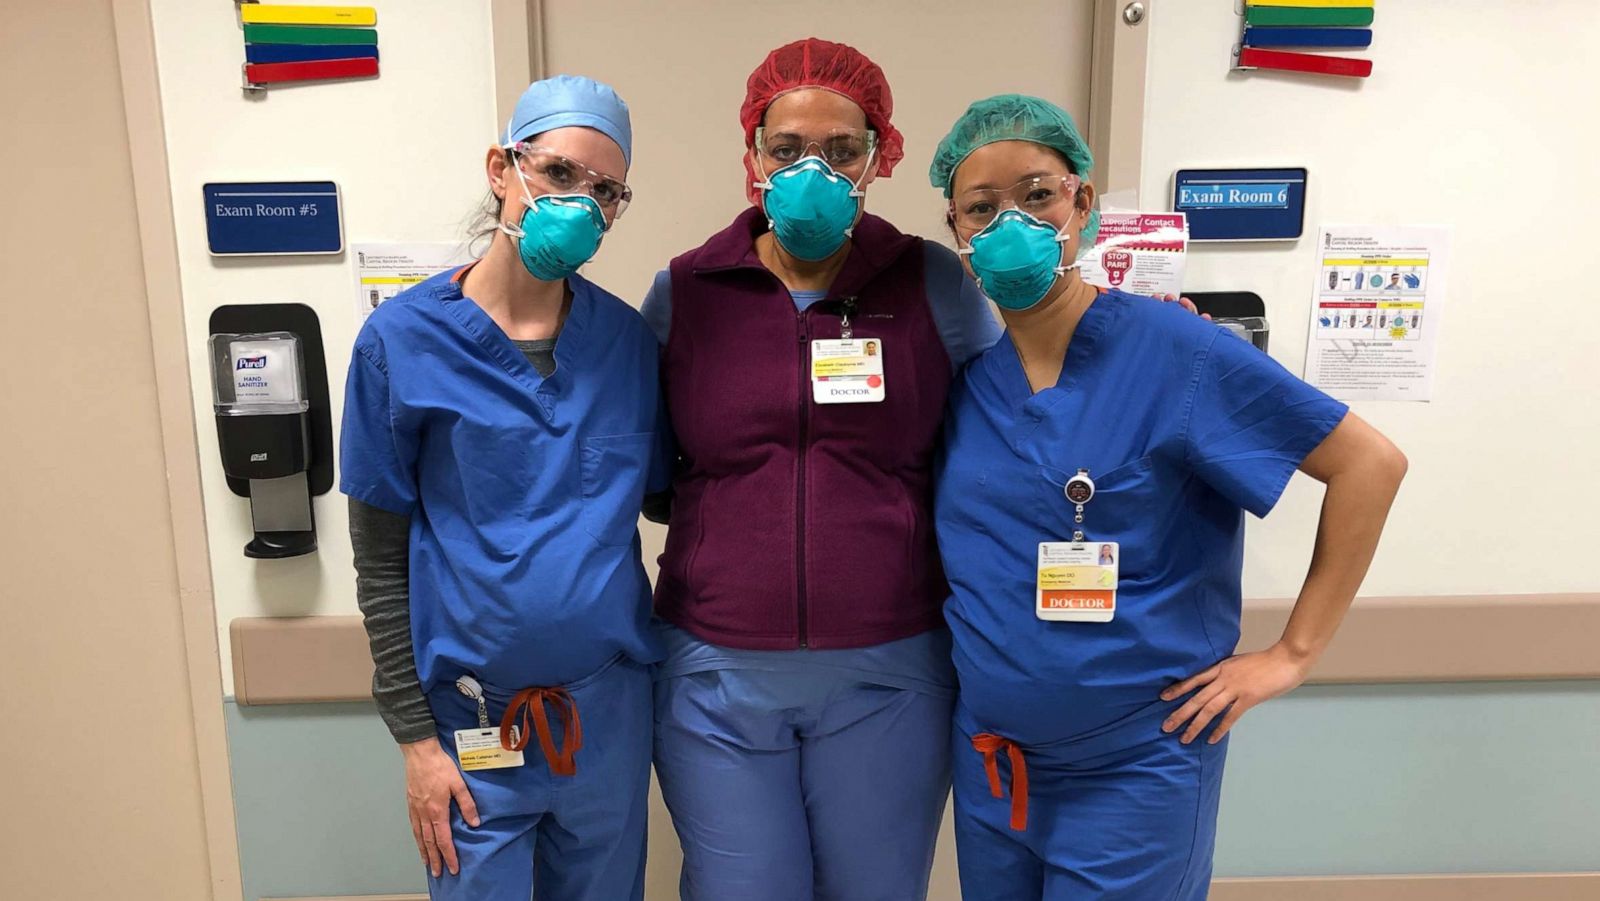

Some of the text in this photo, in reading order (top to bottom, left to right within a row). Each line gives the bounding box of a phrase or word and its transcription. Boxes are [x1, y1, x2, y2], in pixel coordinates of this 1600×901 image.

[1180, 189, 1288, 203] Exam Room 6
[215, 203, 318, 217] Exam Room #5
[1109, 218, 1137, 226] Droplet
[1144, 218, 1175, 226] Contact
[830, 388, 870, 396] DOCTOR
[1049, 598, 1105, 608] DOCTOR
